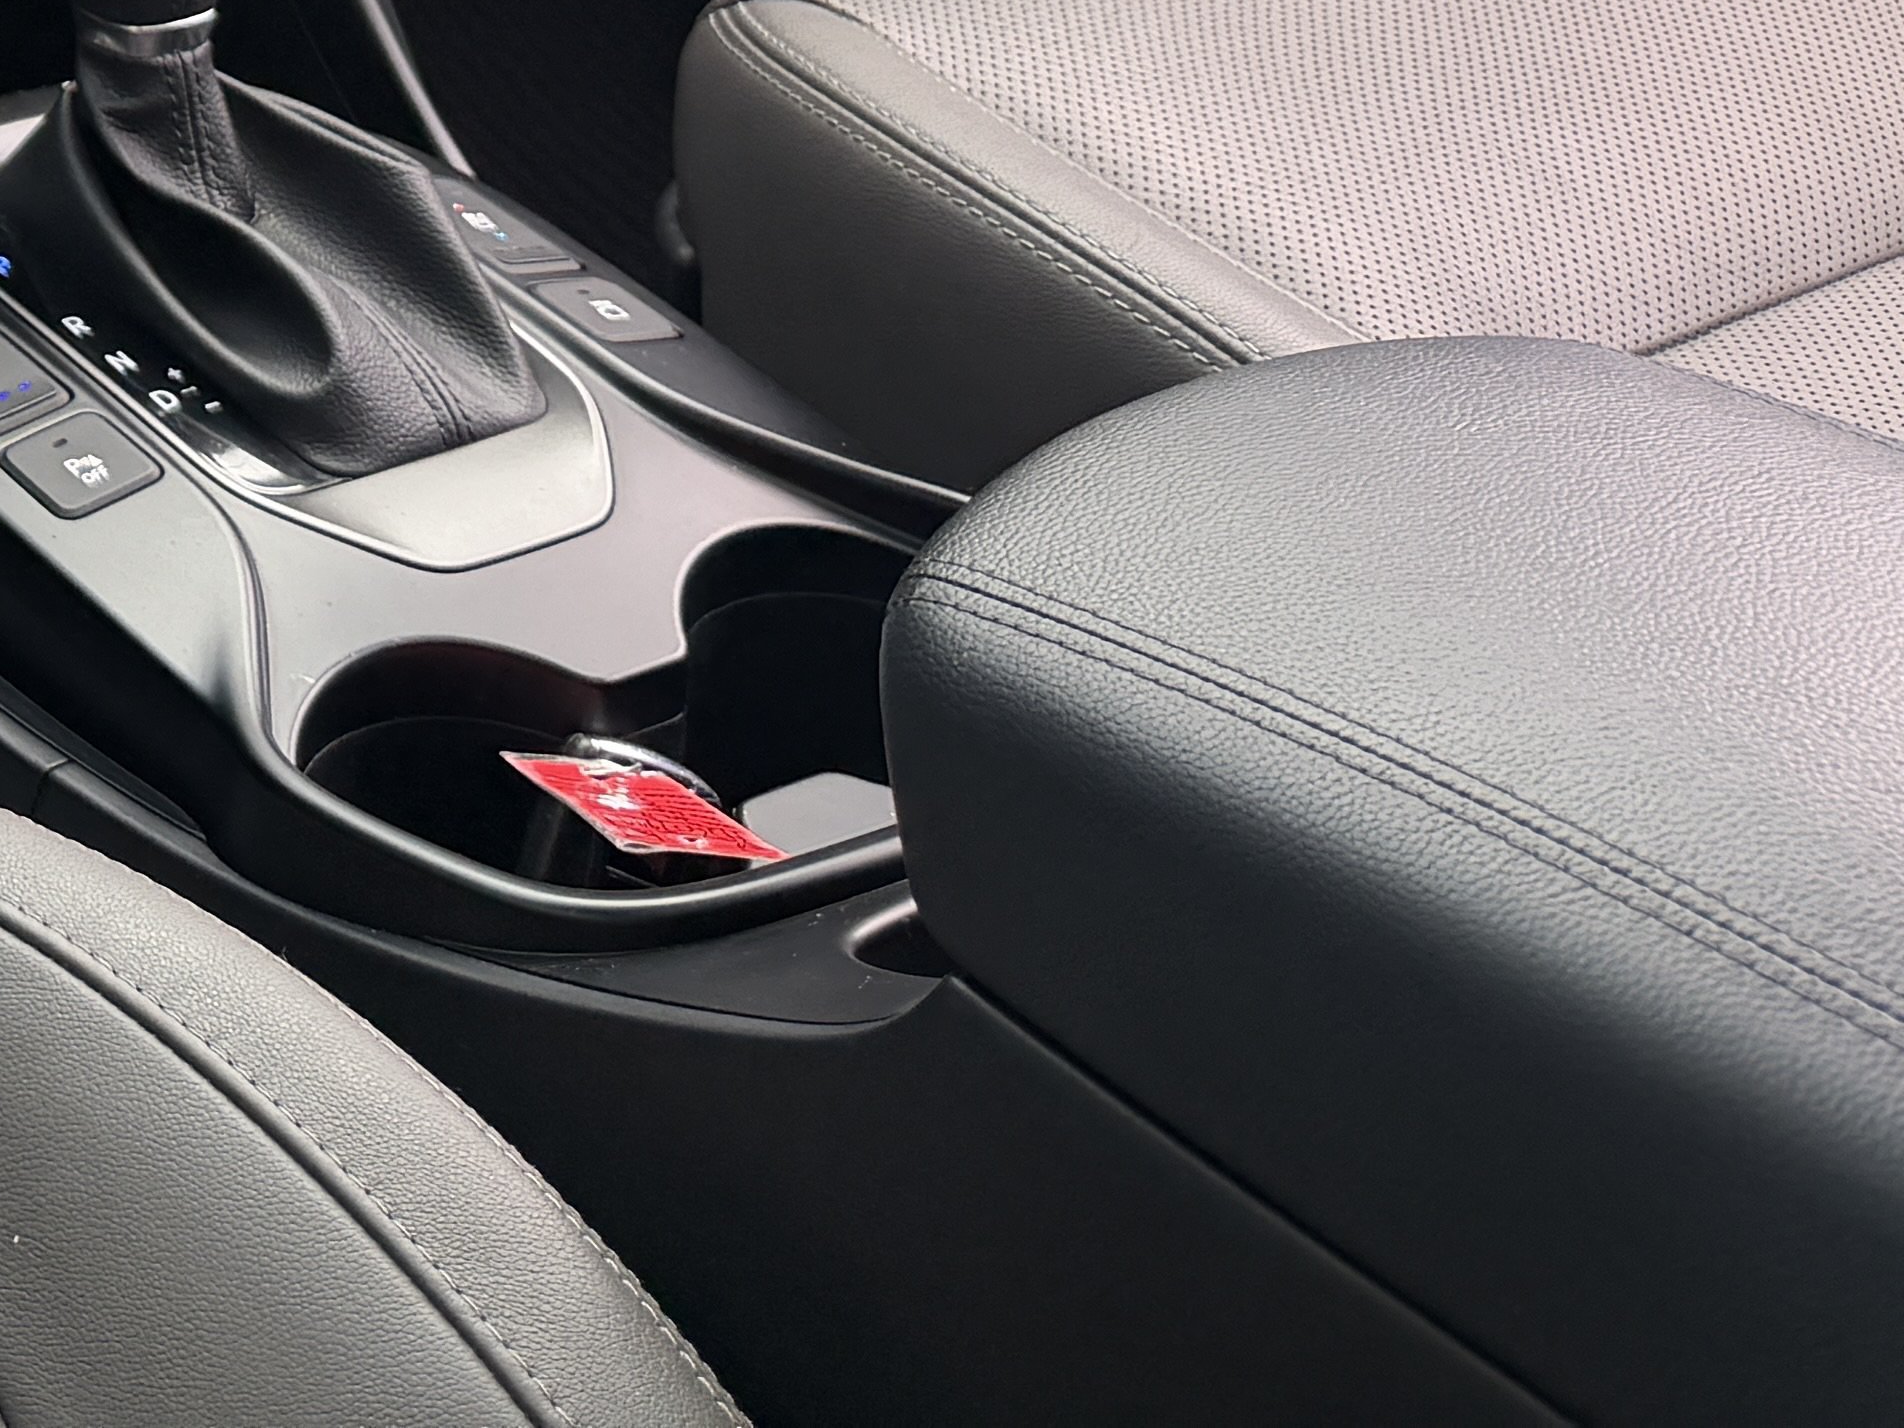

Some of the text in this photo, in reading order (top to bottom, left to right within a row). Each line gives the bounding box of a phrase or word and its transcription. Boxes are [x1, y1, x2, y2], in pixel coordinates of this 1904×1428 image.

[60, 315, 95, 341] R
[103, 350, 141, 377] N
[148, 389, 183, 415] D
